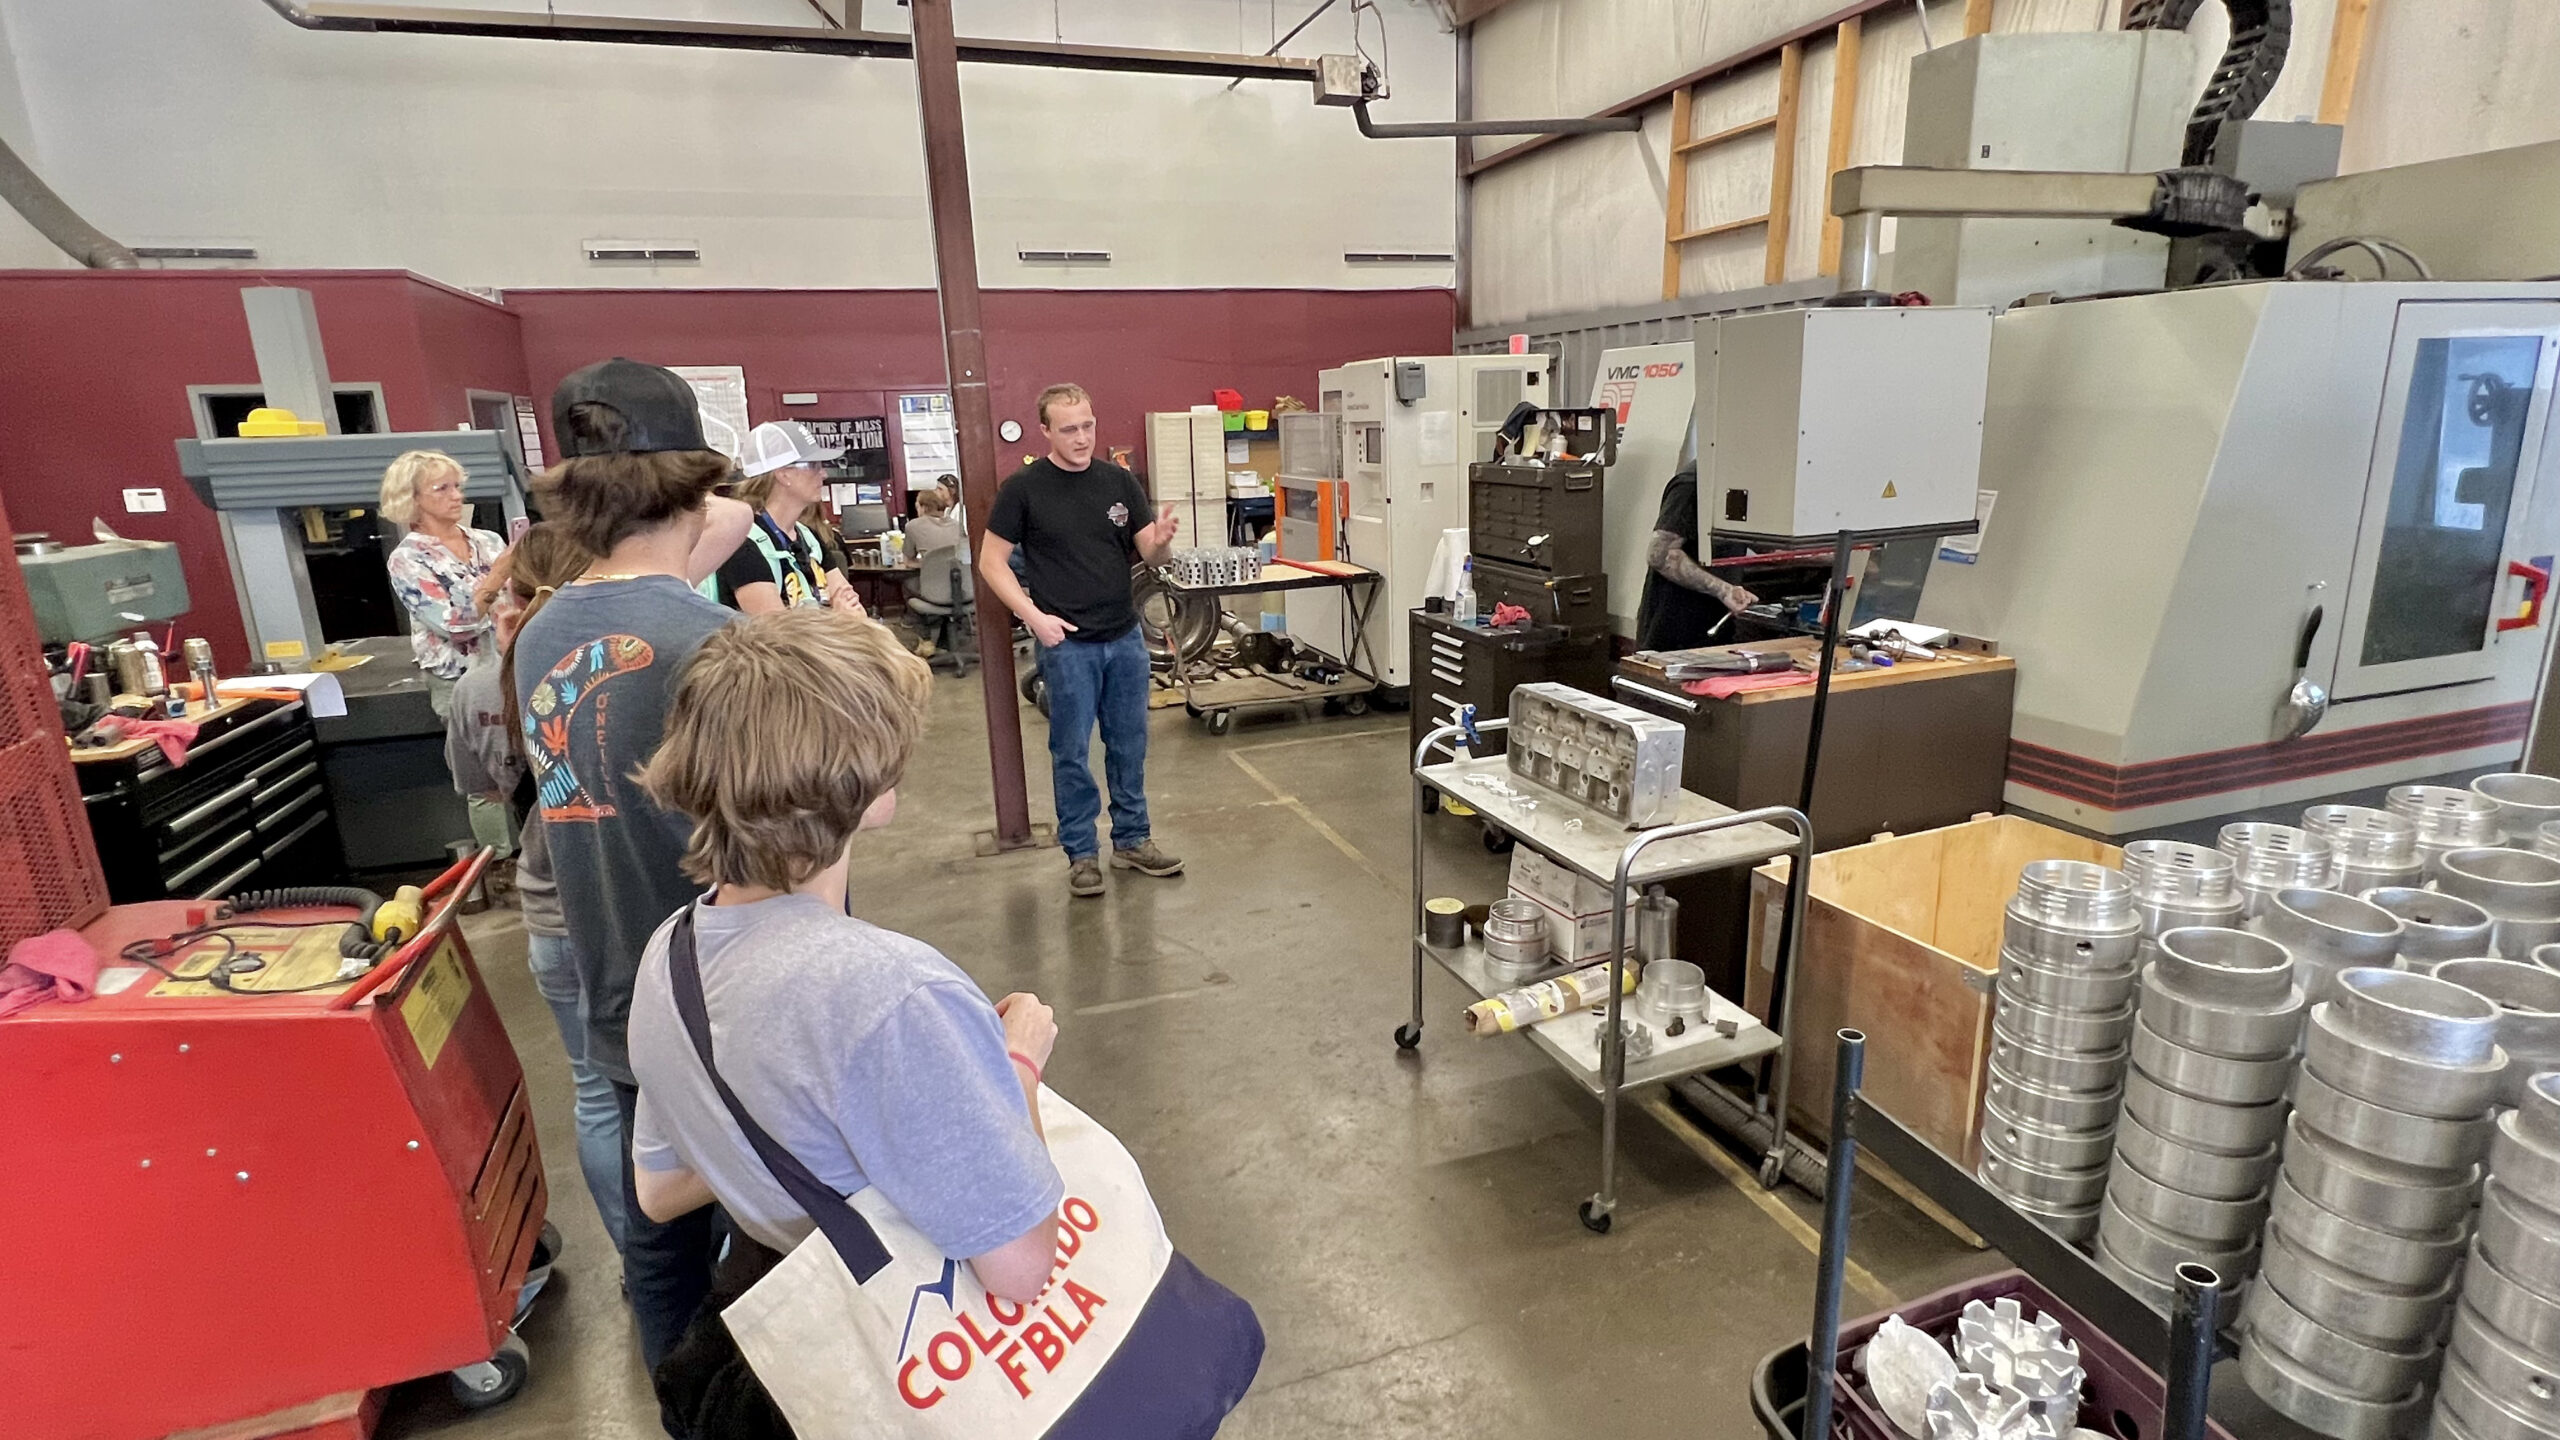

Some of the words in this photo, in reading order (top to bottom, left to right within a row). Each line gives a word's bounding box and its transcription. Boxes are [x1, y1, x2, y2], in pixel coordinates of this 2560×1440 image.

[1607, 365, 1640, 380] VMC
[1643, 362, 1682, 378] 1050
[840, 421, 852, 433] OF
[854, 419, 882, 432] MASS
[897, 1196, 1100, 1410] COLODO
[995, 1278, 1108, 1400] FBLA
